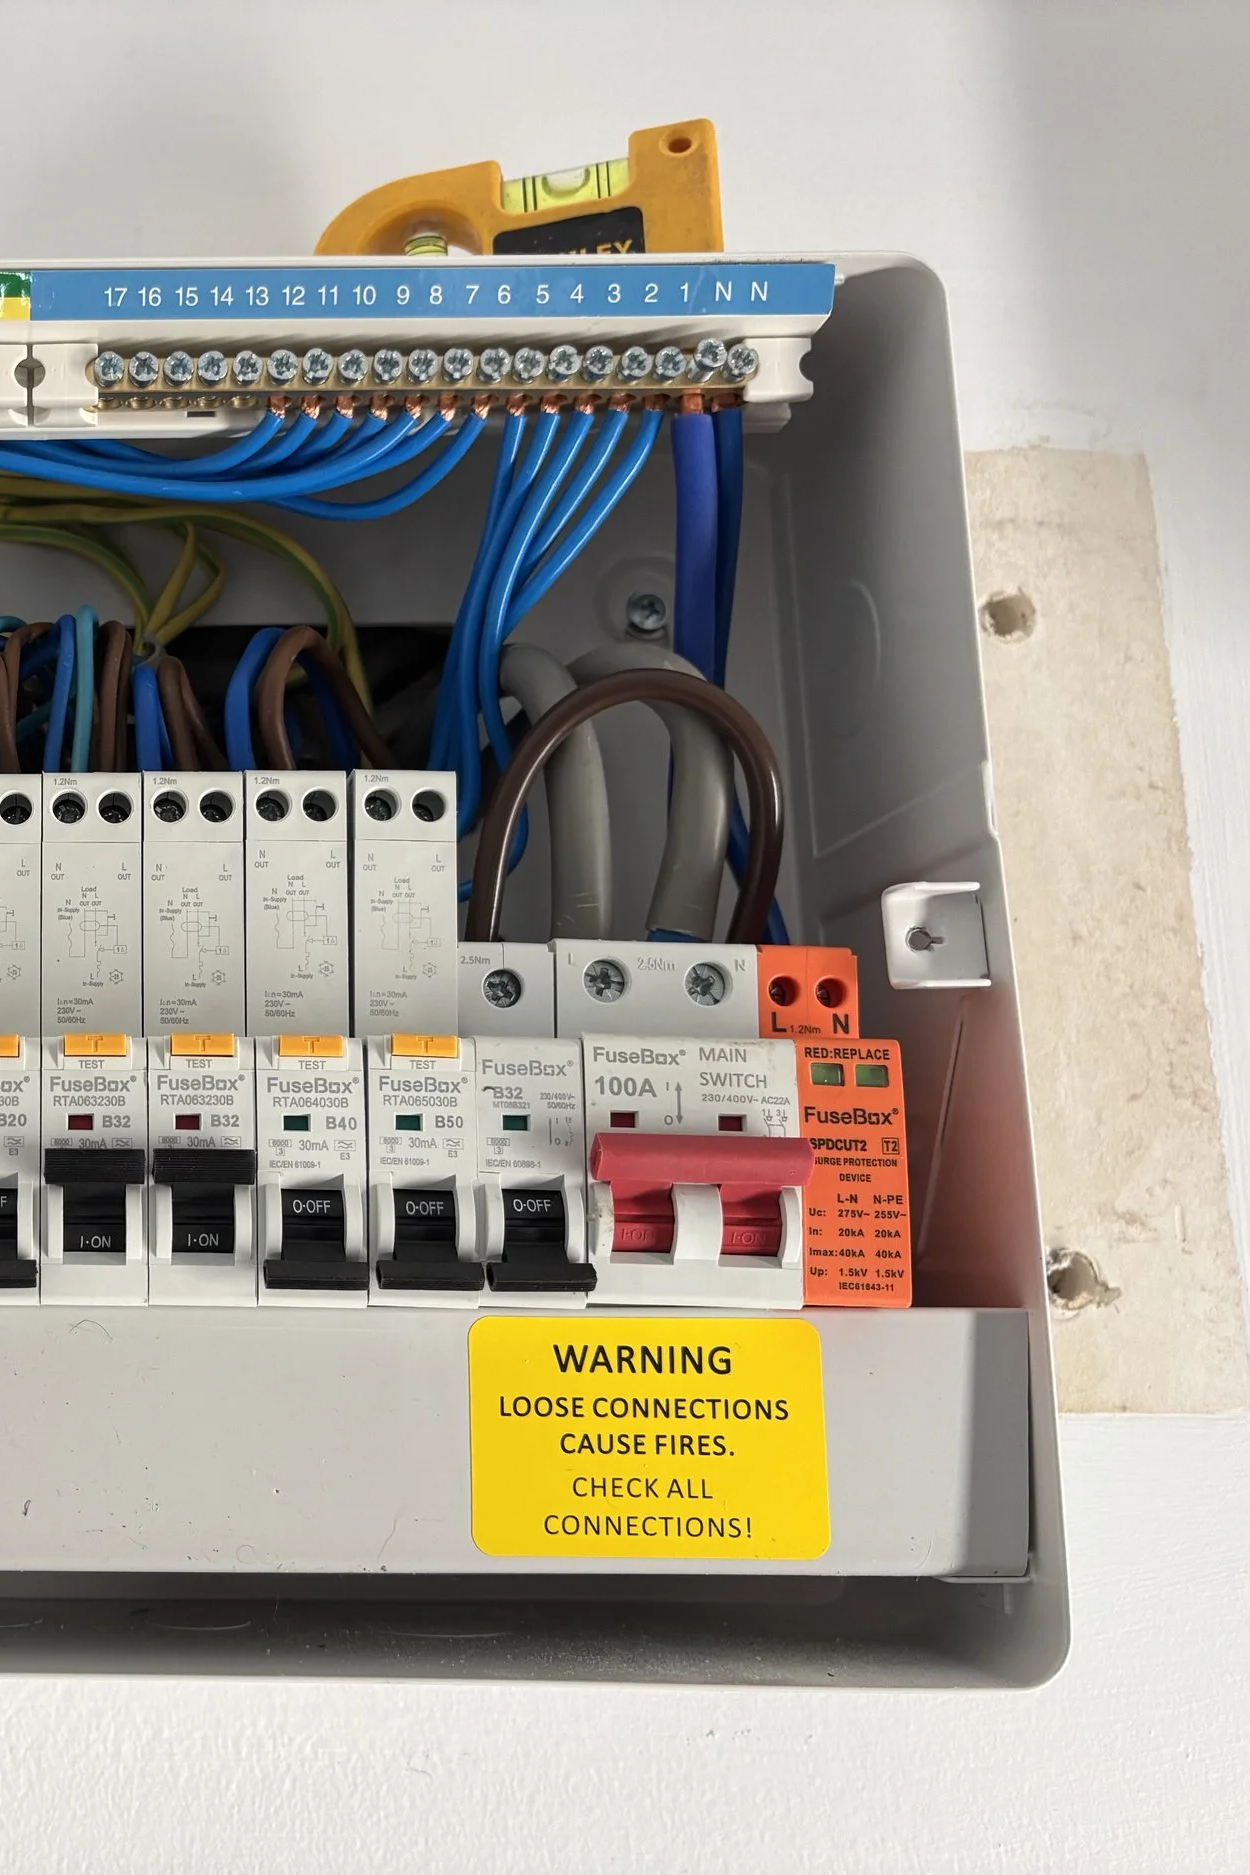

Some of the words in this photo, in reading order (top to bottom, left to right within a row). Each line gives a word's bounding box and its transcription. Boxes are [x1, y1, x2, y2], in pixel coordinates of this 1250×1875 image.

[105, 287, 127, 306] 17
[138, 287, 161, 306] 16
[176, 287, 198, 306] 15
[211, 286, 233, 306] 14
[246, 286, 269, 305] 13
[282, 286, 305, 305] 12
[318, 286, 337, 305] 11
[353, 286, 376, 305] 10
[397, 285, 409, 304] 9
[430, 285, 442, 304] 8
[466, 285, 479, 304] 7
[498, 285, 510, 304] 6
[536, 285, 549, 303] 5
[571, 284, 583, 303] 4
[608, 284, 620, 303] 3
[645, 283, 658, 302] 2
[681, 283, 688, 302] 1
[716, 282, 731, 301] N
[751, 282, 767, 301] N
[461, 956, 490, 964] 2.5Nm
[772, 1012, 787, 1032] L
[790, 1025, 820, 1034] 1.2Nm
[833, 1014, 849, 1034] N
[699, 1047, 746, 1062] MAIN
[805, 1047, 890, 1060] RED:REPLACE
[78, 1060, 104, 1071] TEST
[410, 1060, 436, 1069] TEST
[700, 1072, 767, 1088] SWITCH
[595, 1076, 657, 1097] 100A
[161, 1094, 233, 1105] RTA063230B
[492, 1086, 523, 1102] B32
[54, 1096, 125, 1106] RTA063230B
[273, 1097, 348, 1108] RTA064030B
[383, 1095, 457, 1107] RTA065030B
[761, 1096, 790, 1105] AC22A
[103, 1115, 130, 1128] B32
[211, 1114, 239, 1127] B32
[326, 1116, 357, 1130] B40
[436, 1116, 463, 1128] B50
[299, 1140, 328, 1151] 30mA
[811, 1138, 868, 1152] SPDCUT2
[884, 1140, 899, 1152] T2
[843, 1157, 898, 1167] PROTECTION
[840, 1173, 871, 1182] DEVICE
[838, 1193, 857, 1204] L-N
[874, 1195, 903, 1204] N-PE
[809, 1208, 826, 1216] Uc:
[839, 1228, 864, 1237] 20kA
[875, 1230, 901, 1238] 20kA
[839, 1249, 865, 1257] 40kA
[875, 1250, 901, 1258] 40kA
[810, 1267, 827, 1277] Up:
[839, 1268, 867, 1276] 1.5kV
[876, 1269, 904, 1278] 1.5kV
[553, 1345, 731, 1374] WARNING
[500, 1396, 584, 1417] LOOSE
[593, 1398, 788, 1420] CONNECTIONS
[561, 1434, 646, 1454] CAUSE
[656, 1435, 734, 1456] FIRES.
[573, 1477, 658, 1498] CHECK
[667, 1479, 713, 1498] ALL
[545, 1515, 751, 1538] CONNECTIONS!
